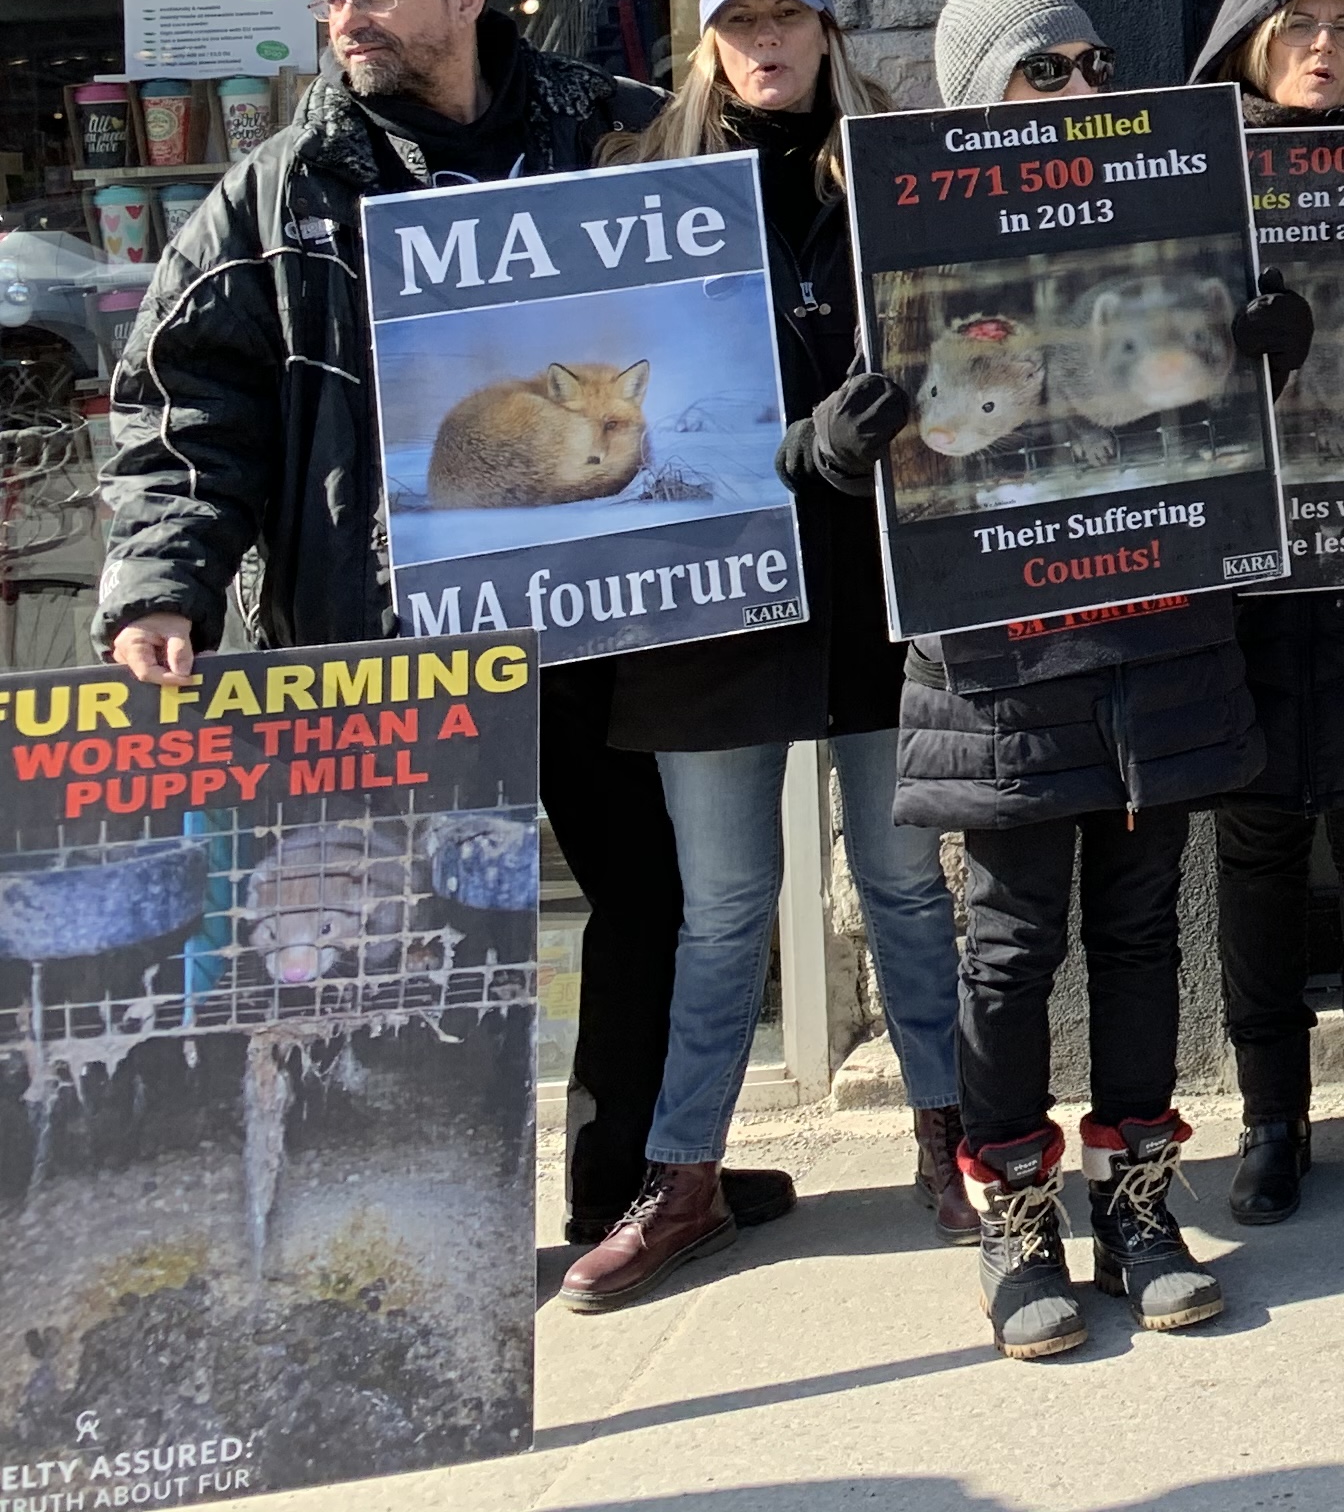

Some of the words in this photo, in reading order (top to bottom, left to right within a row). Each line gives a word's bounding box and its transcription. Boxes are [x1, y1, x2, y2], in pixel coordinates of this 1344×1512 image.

[944, 118, 1058, 154] Canada
[1066, 109, 1152, 145] killed
[895, 173, 920, 206] 2
[931, 164, 1009, 202] 771
[1019, 156, 1094, 195] 500
[1102, 149, 1208, 185] minks
[1298, 190, 1331, 208] en
[999, 205, 1031, 235] in
[1038, 198, 1115, 232] 2013
[1254, 220, 1331, 244] ment
[395, 211, 560, 296] MA
[581, 194, 727, 269] vie
[974, 519, 1061, 553] Their
[1068, 501, 1206, 539] Suffering
[1291, 497, 1329, 521] les
[1023, 540, 1161, 587] Counts!
[1226, 554, 1277, 576] KARA
[408, 580, 508, 639] MA
[526, 549, 788, 631] fourrure
[745, 602, 798, 623] KARA
[0, 682, 131, 737] UR
[159, 645, 529, 725] FARMING
[13, 726, 233, 781] WORSE
[253, 708, 419, 758] THAN
[438, 703, 479, 740] A
[65, 762, 270, 819] PUPPY
[290, 750, 429, 796] MILL
[0, 1458, 81, 1491] ELTY
[90, 1437, 254, 1481] ASSURED:
[94, 1476, 190, 1509] ABOUT
[198, 1468, 250, 1495] FUR
